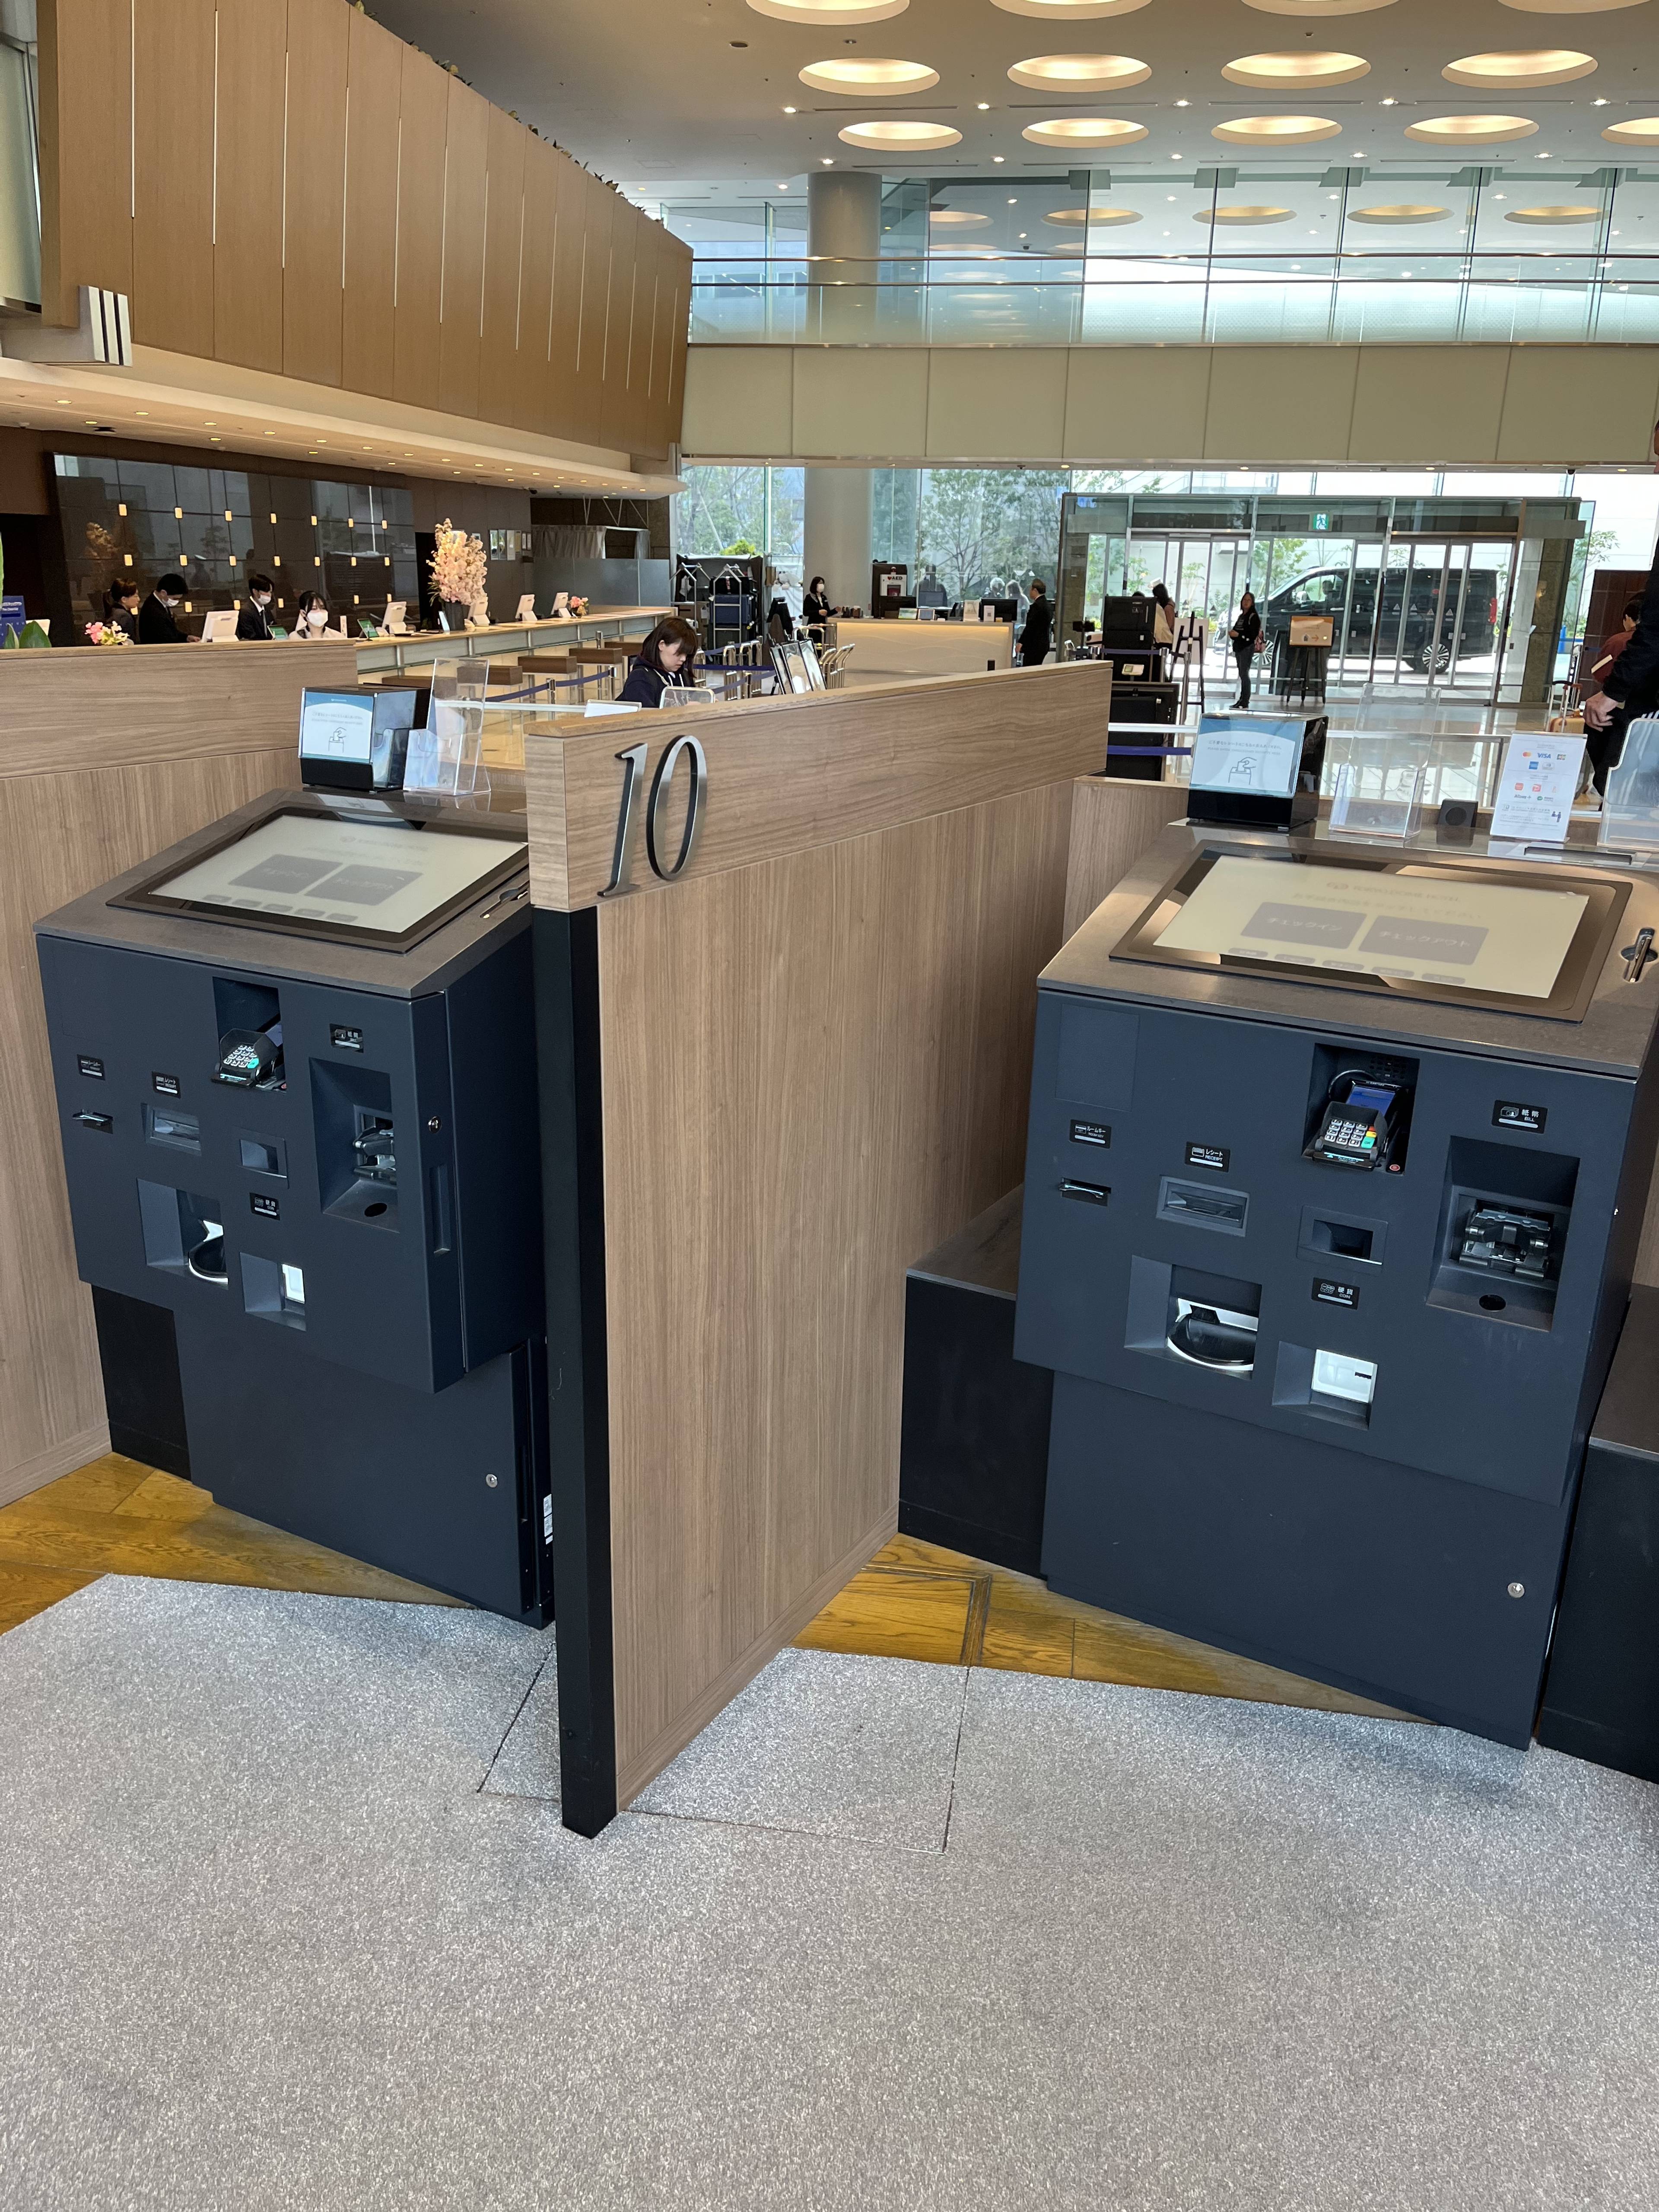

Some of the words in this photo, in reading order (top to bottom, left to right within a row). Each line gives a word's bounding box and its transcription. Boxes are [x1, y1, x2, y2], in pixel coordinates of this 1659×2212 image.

[597, 735, 708, 897] 10
[1267, 916, 1342, 931] チェックイン
[1379, 931, 1471, 947] チェックアウト
[1206, 1148, 1223, 1157] レシート
